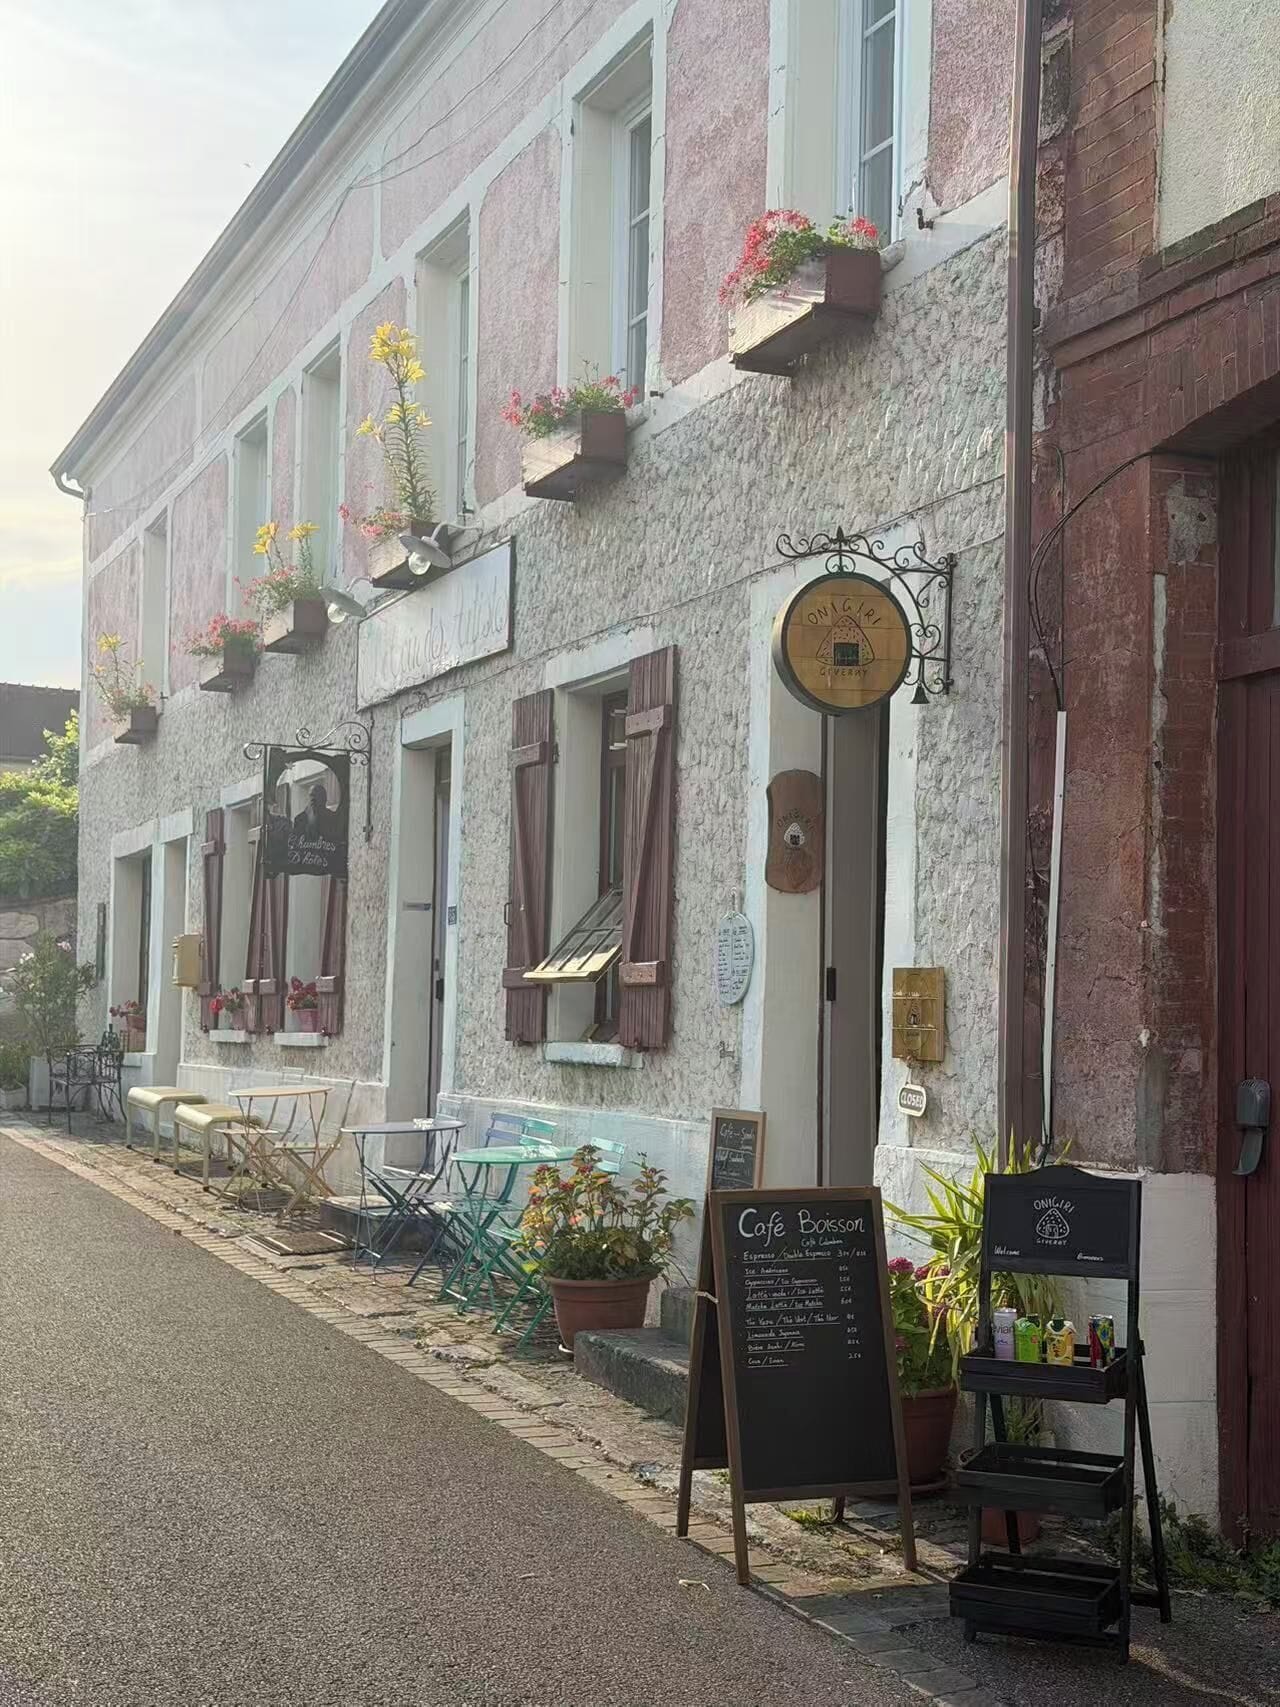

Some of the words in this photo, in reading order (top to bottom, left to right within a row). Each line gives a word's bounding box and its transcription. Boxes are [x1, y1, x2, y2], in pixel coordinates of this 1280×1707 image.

[807, 597, 883, 626] ONIGIRI
[818, 666, 869, 678] GIVERNY
[287, 833, 337, 851] Chambres
[901, 1091, 925, 1108] CLOSED
[1033, 1195, 1075, 1214] ONIGIRI
[738, 1208, 786, 1247] Café
[797, 1207, 865, 1234] Boisson
[743, 1250, 776, 1262] Espresso
[993, 1245, 1021, 1256] Welcome
